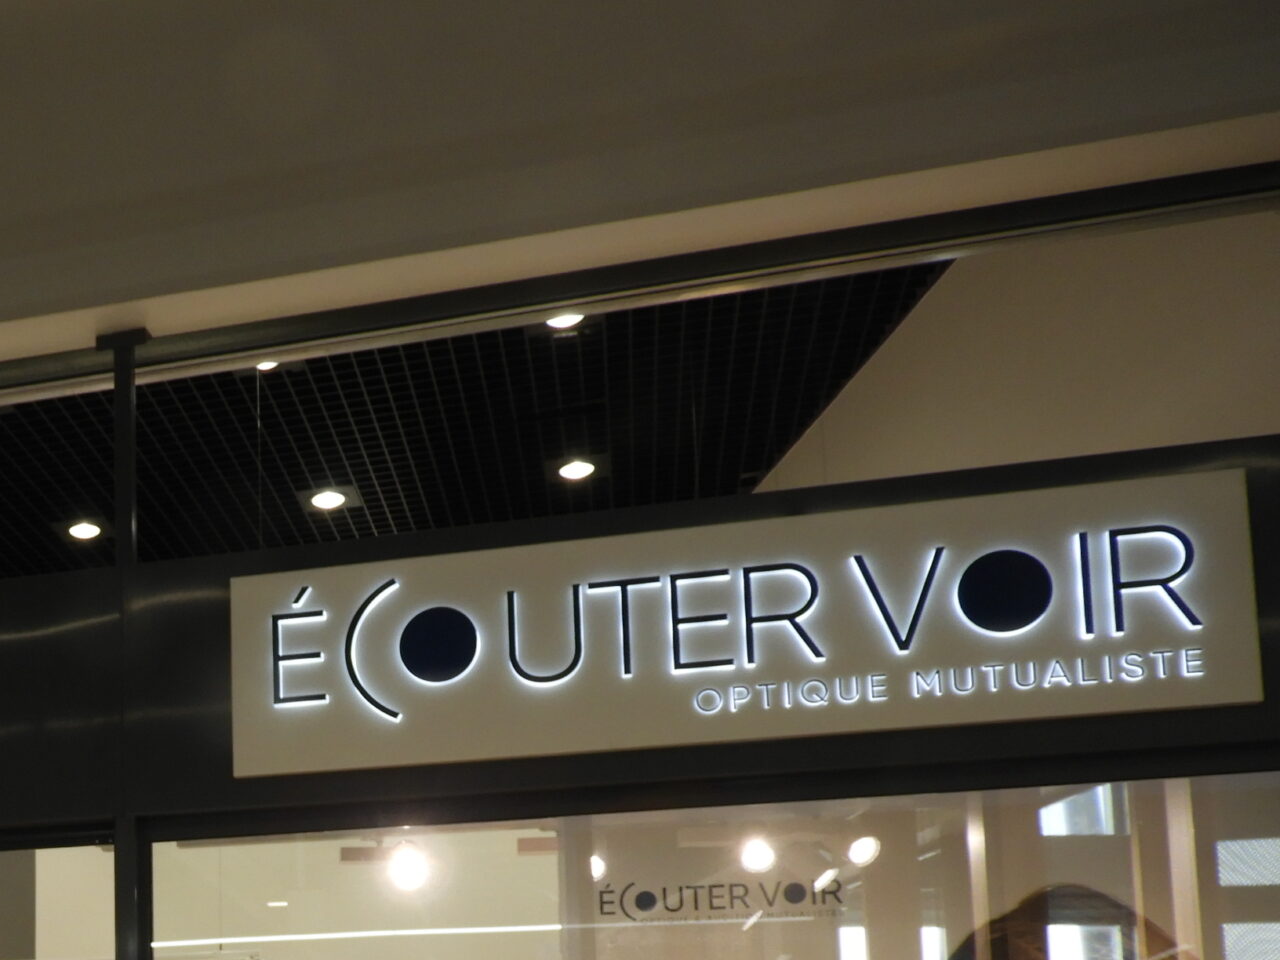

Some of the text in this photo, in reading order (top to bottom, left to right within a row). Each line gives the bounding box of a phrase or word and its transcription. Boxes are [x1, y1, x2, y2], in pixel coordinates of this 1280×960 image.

[272, 525, 1204, 723] ÉCOUTER VOIR
[693, 648, 1206, 714] OPTIQUE MUTUALISTE
[599, 882, 749, 921] ÉCOUTER
